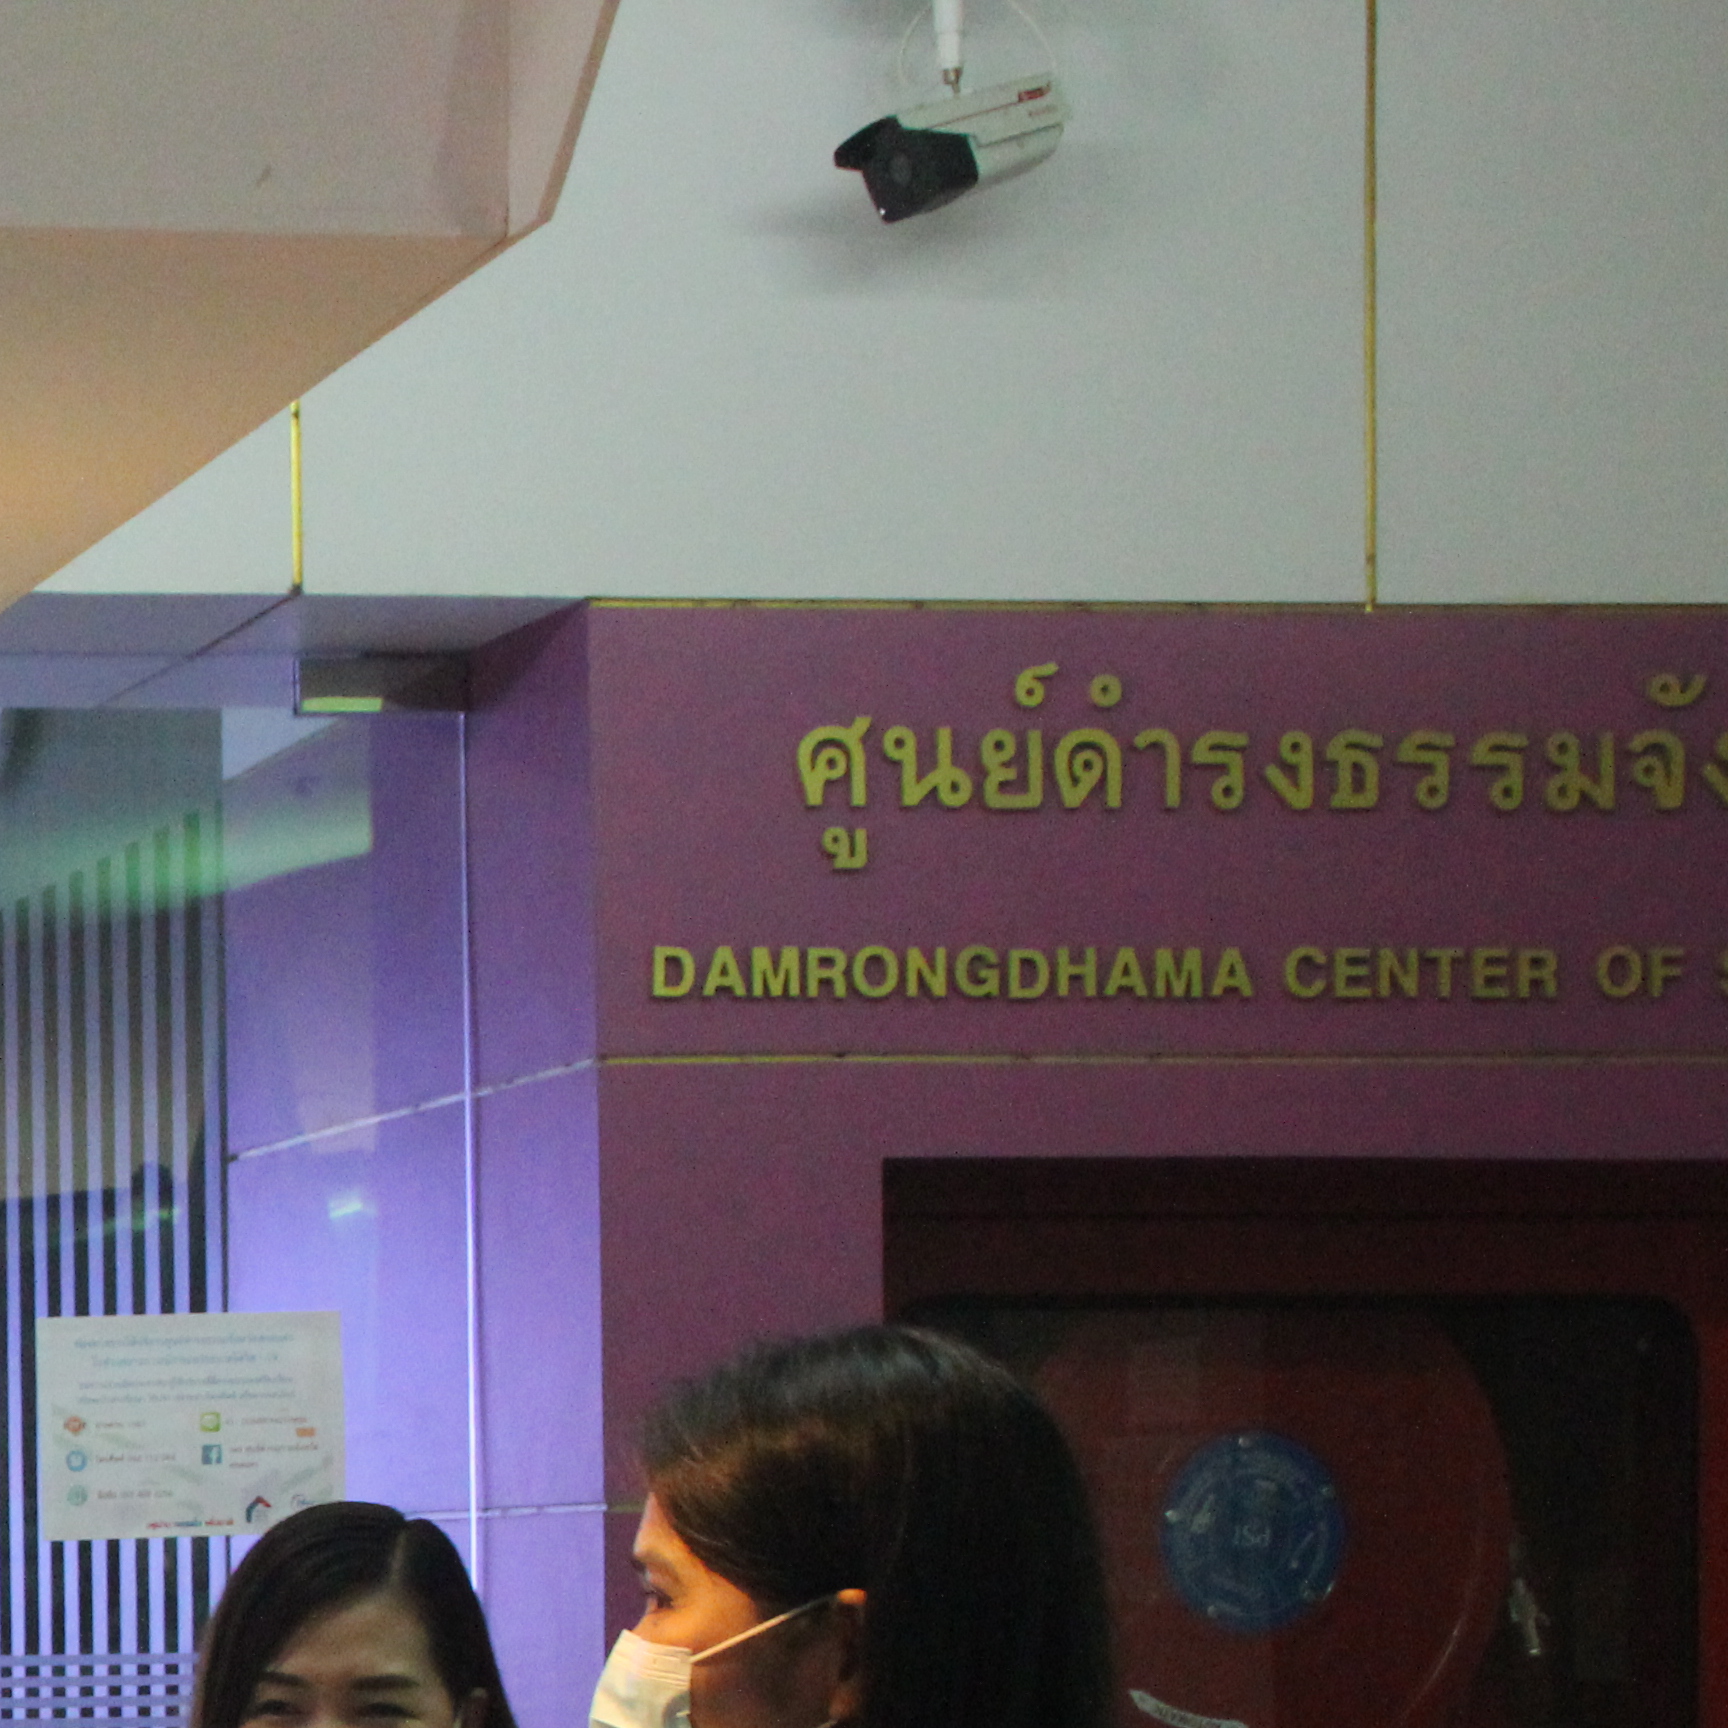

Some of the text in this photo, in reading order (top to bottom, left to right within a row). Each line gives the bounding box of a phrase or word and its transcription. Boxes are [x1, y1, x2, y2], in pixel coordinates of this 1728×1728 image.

[650, 944, 1254, 1000] DAMRONGDHAMA
[1283, 945, 1559, 999] CENTER
[1597, 945, 1684, 998] OF
